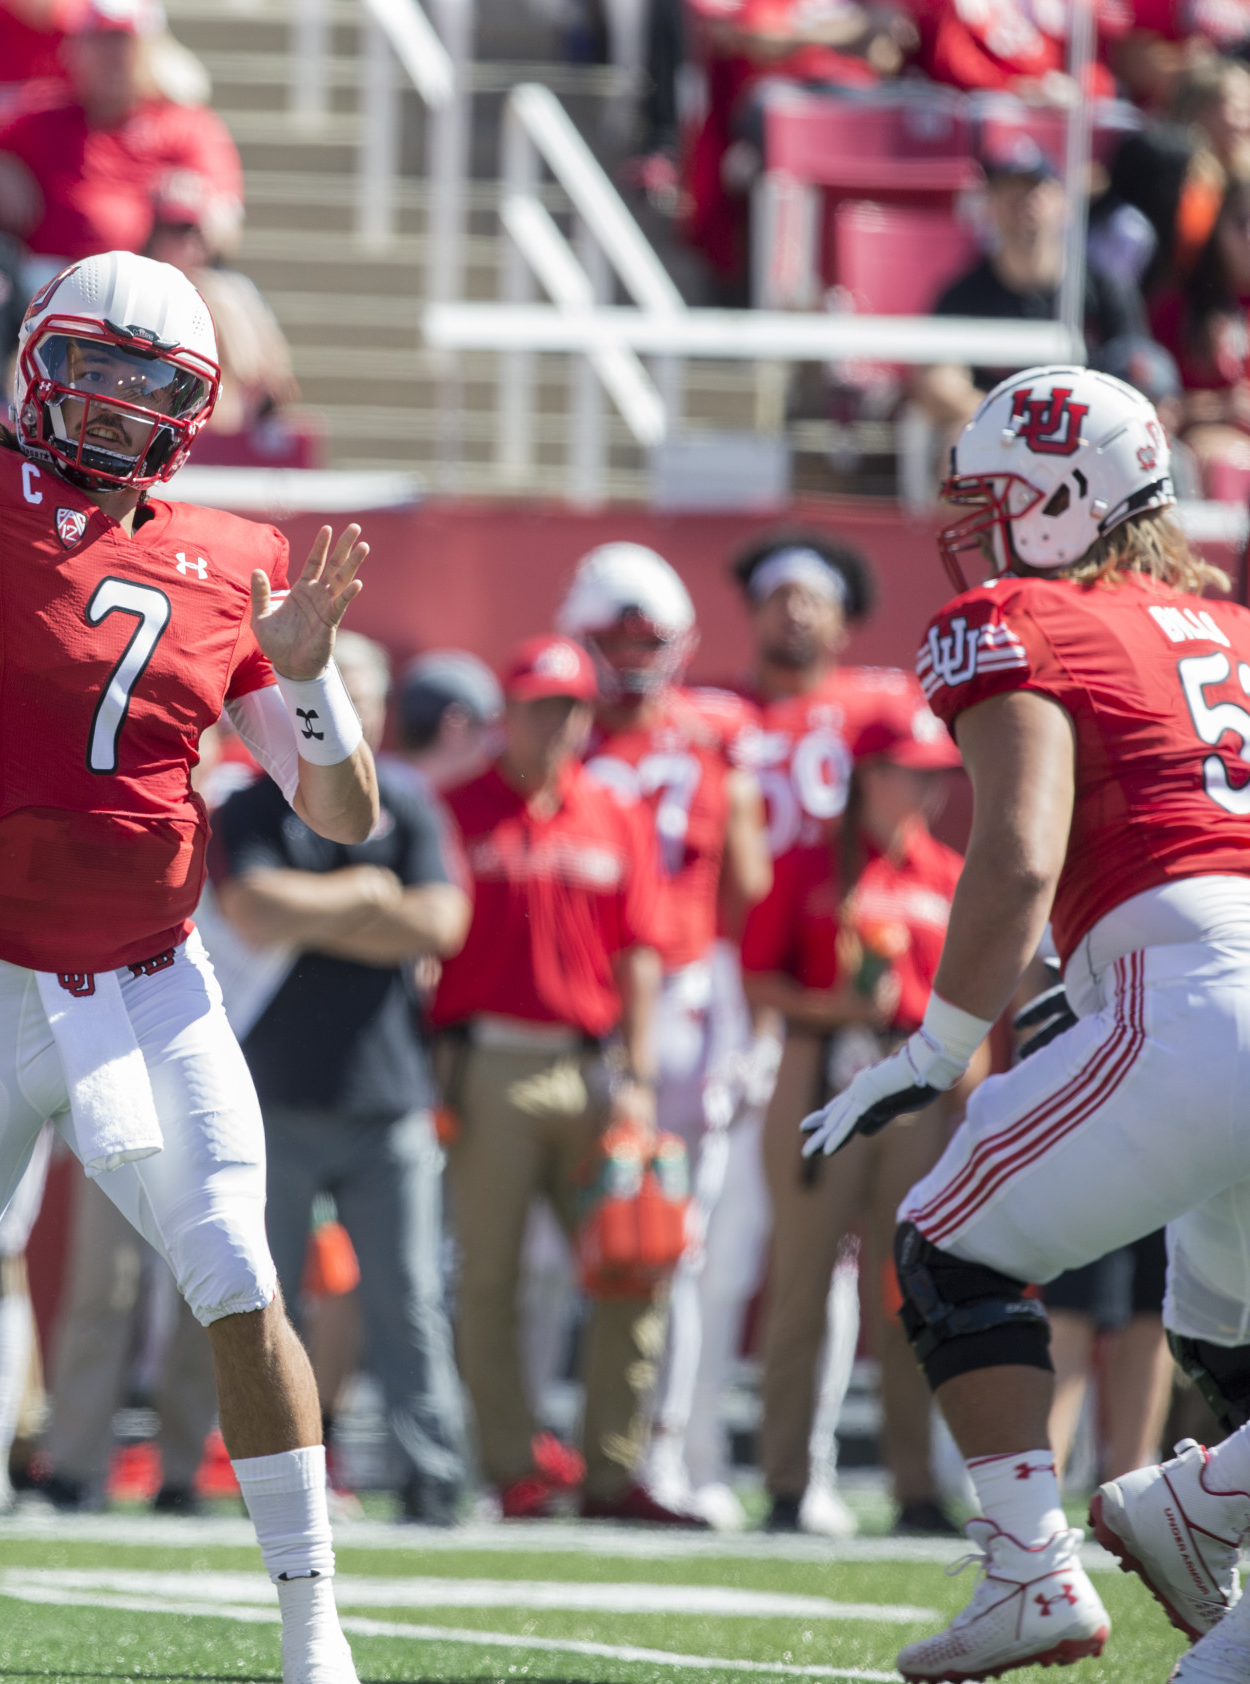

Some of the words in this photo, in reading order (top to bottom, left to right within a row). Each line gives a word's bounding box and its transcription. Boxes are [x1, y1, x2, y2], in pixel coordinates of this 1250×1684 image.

[21, 462, 43, 504] C
[57, 508, 87, 535] PAC
[62, 523, 77, 541] 12
[85, 575, 172, 775] 7
[1164, 1507, 1187, 1552] UNDER
[1181, 1553, 1210, 1595] ARMOUR
